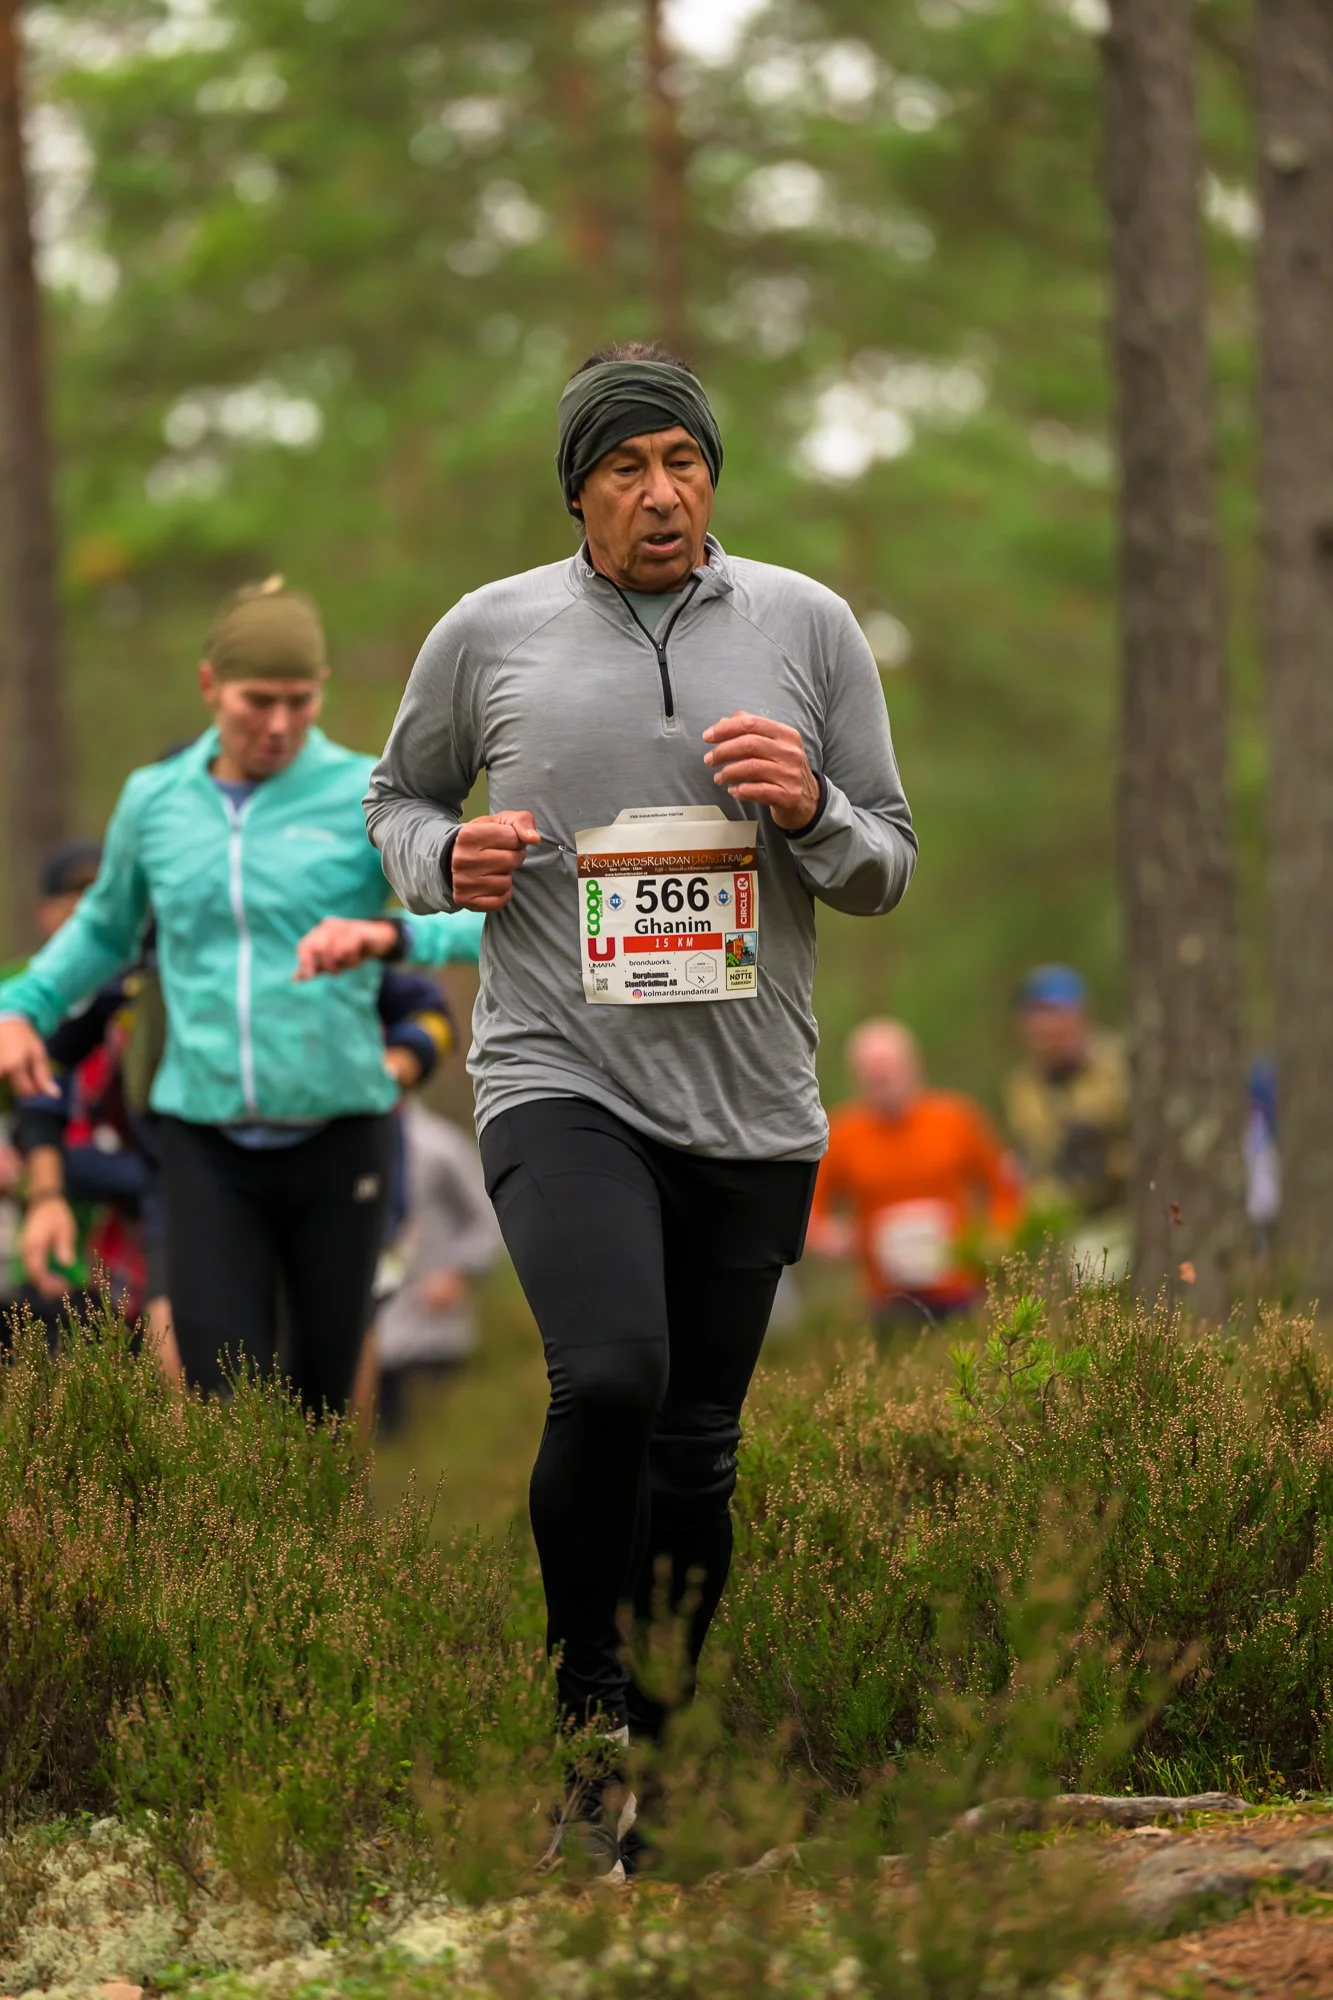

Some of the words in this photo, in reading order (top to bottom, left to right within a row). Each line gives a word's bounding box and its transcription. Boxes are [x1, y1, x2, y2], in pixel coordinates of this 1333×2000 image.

[635, 877, 710, 914] 566
[585, 879, 602, 936] coop
[740, 891, 748, 925] CIRCLE
[634, 916, 712, 934] Ghanim
[655, 938, 669, 948] 15
[677, 936, 693, 947] KM
[632, 972, 669, 980] Borghamns
[729, 972, 753, 980] NØTTE
[643, 988, 719, 997] kolmardsrundantrail
